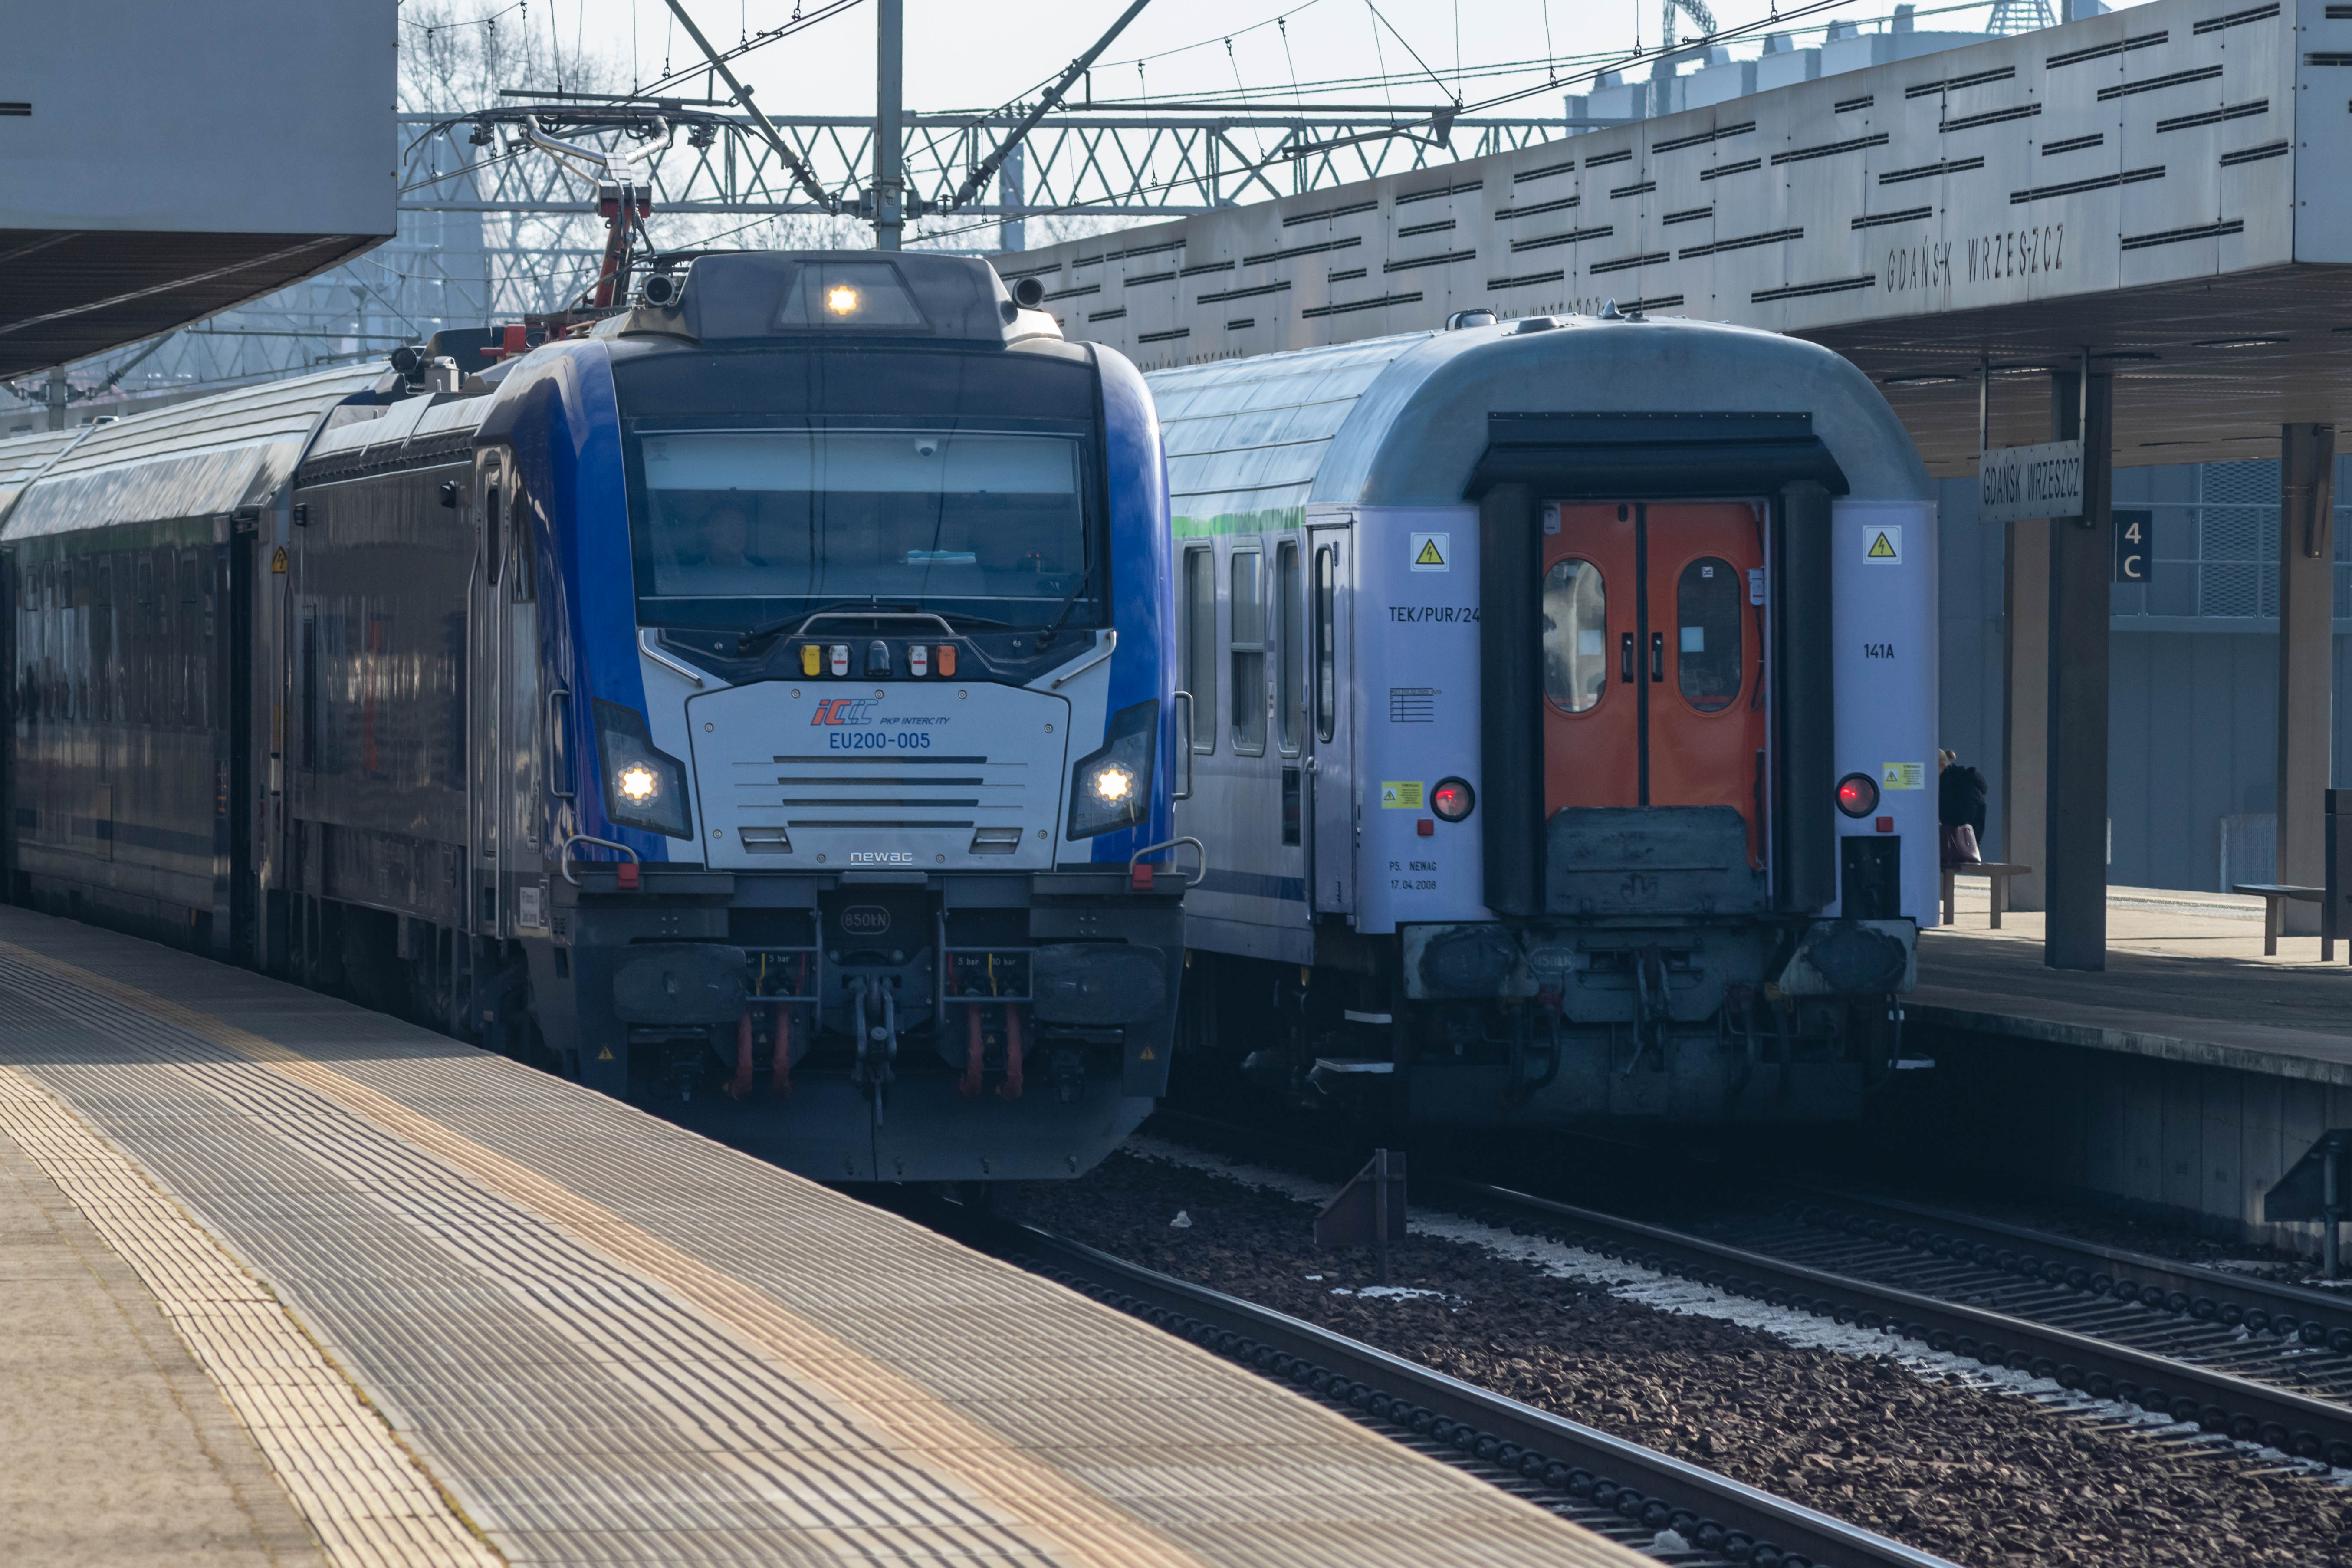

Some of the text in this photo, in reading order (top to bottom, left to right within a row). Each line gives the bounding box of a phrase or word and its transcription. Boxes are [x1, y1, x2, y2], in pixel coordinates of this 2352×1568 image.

[1888, 223, 2063, 293] GDAŃSK WRZESZCZ
[1984, 456, 2079, 505] GDAŃSK WRZESZCZ
[2125, 522, 2142, 544] 4
[2124, 555, 2141, 578] C
[1864, 643, 1895, 659] 141A
[829, 732, 930, 749] EU200-005
[1409, 861, 1436, 871] NEWAG
[844, 913, 886, 927] 850kN
[768, 954, 790, 963] 5 bar
[958, 957, 979, 966] 5 bar
[1003, 957, 1016, 966] bar
